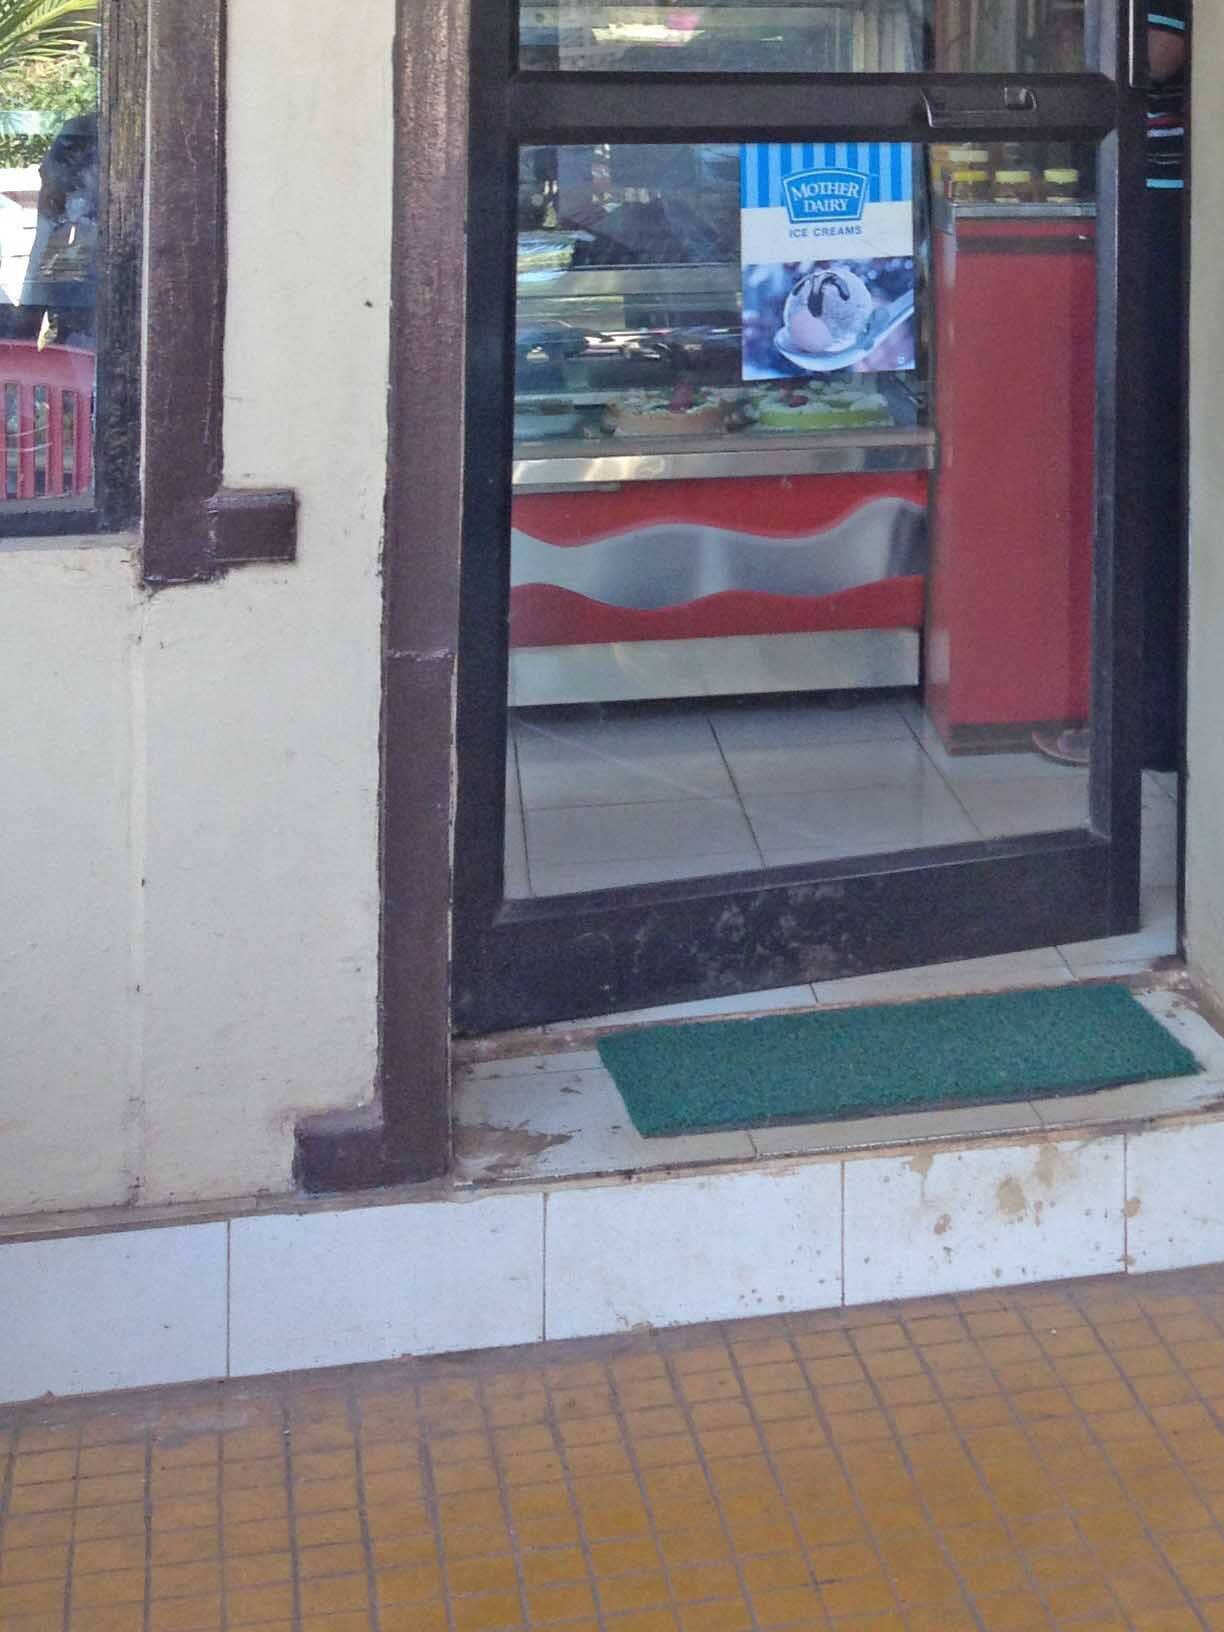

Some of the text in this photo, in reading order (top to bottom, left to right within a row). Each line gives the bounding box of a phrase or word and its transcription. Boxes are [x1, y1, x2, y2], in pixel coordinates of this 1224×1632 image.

[791, 182, 860, 201] MOTHER
[804, 199, 849, 213] DAIRY
[790, 226, 863, 238] ICE CREAMS
